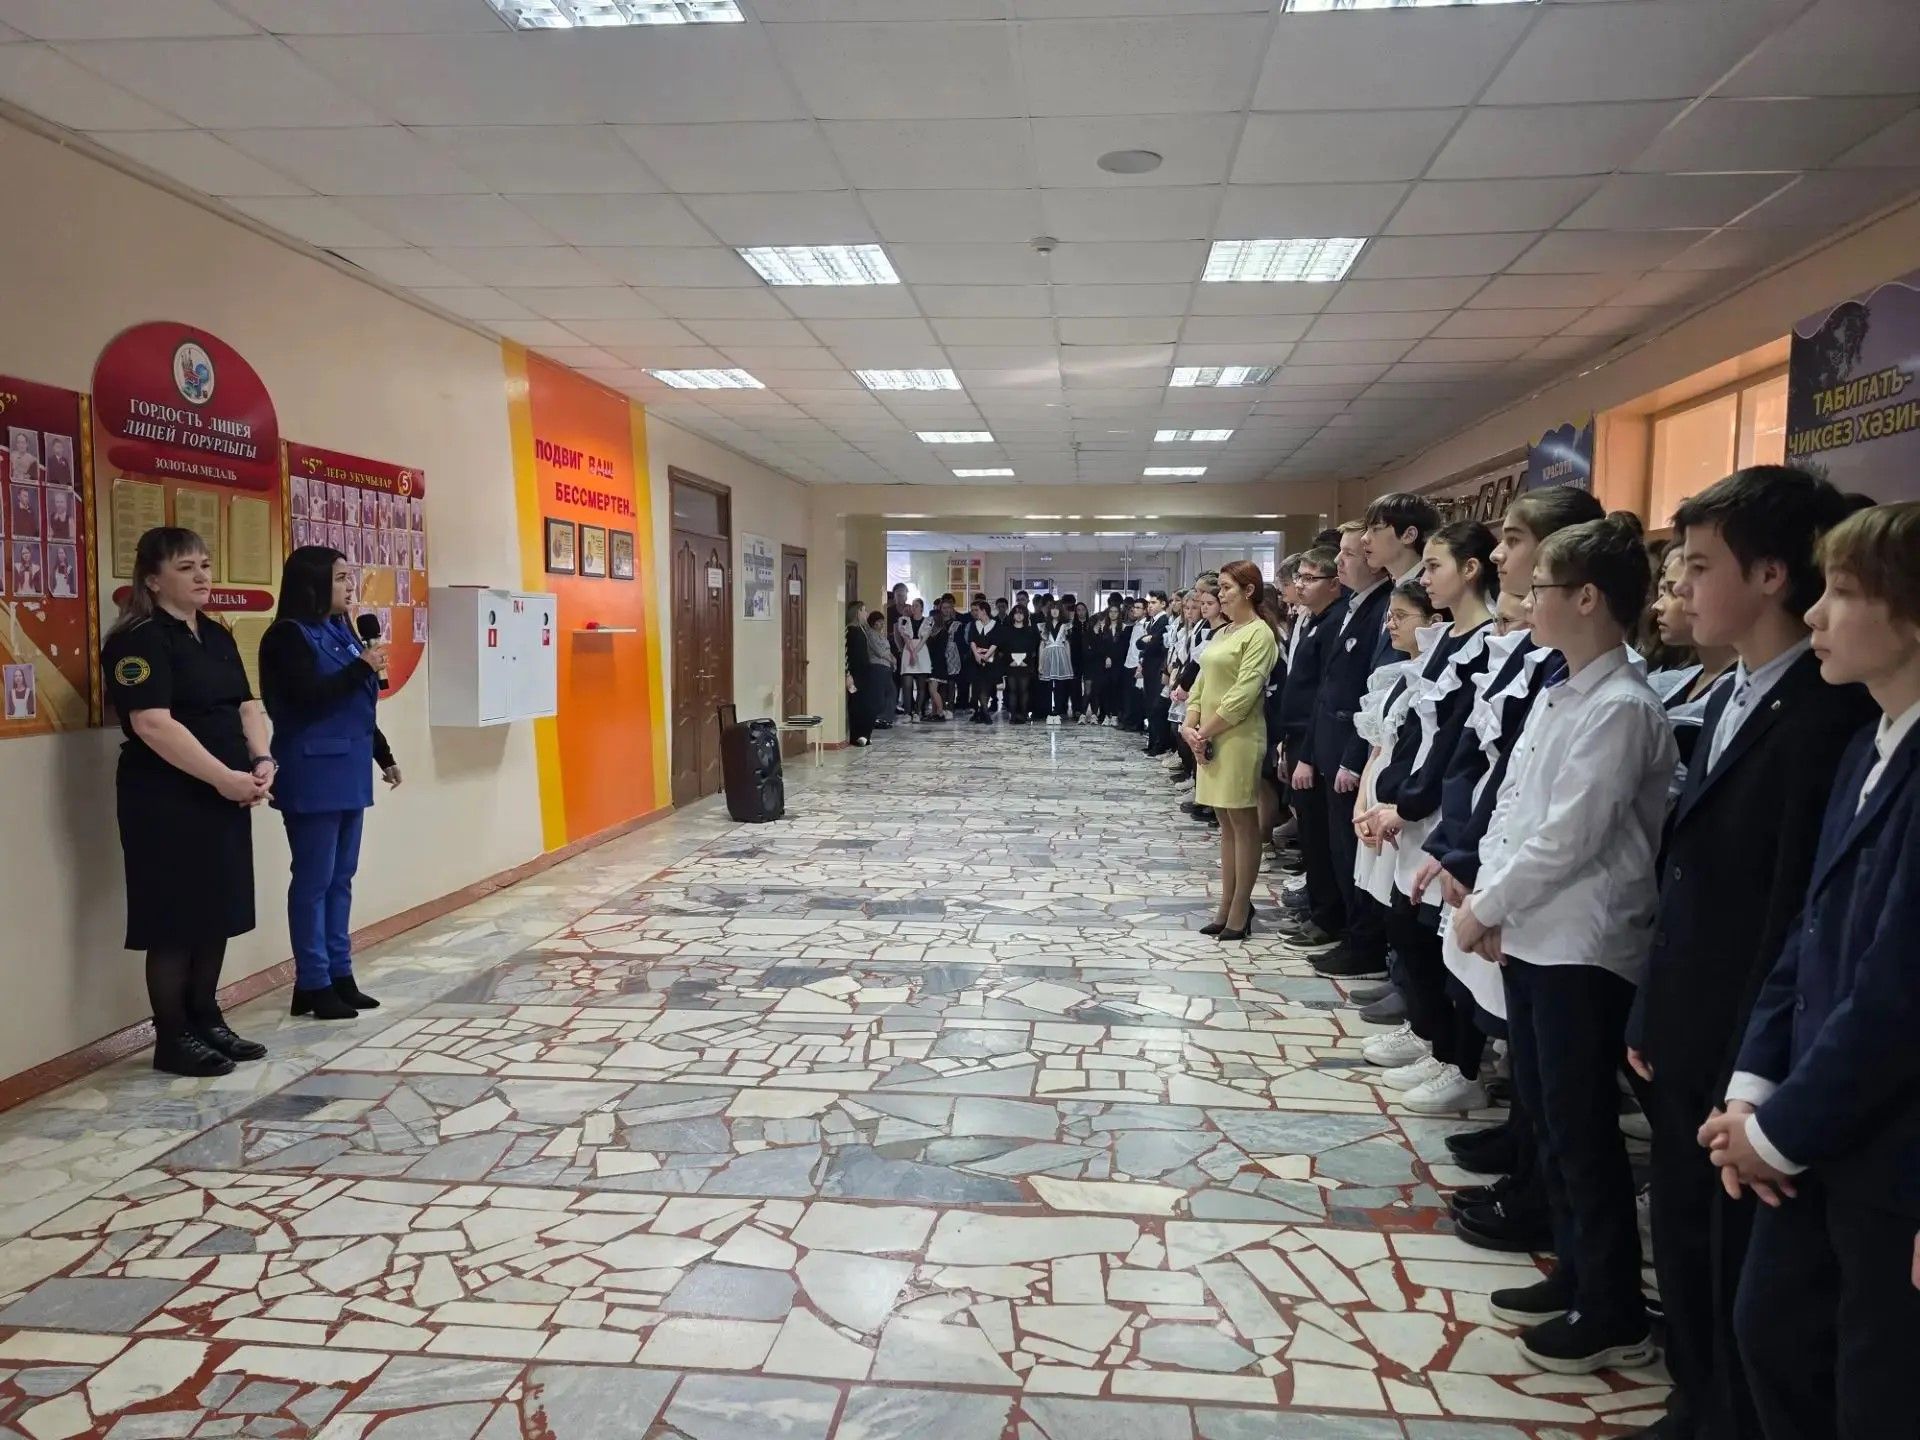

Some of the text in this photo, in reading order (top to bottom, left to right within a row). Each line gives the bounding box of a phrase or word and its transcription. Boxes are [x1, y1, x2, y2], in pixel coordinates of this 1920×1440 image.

[1812, 368, 1912, 416] ТАБИГАТЬ-
[130, 398, 252, 439] ГОРДОСТЬ ЛИЦЕЯ
[123, 419, 257, 459] ЛИЦЕЙ ГОРУРЛЫГЫ
[535, 438, 614, 480] ПОДВИГ ВАШ
[154, 457, 238, 481] ЗОЛОТАЯ МЕДАЛЬ
[210, 592, 248, 605] МЕДАЛЬ
